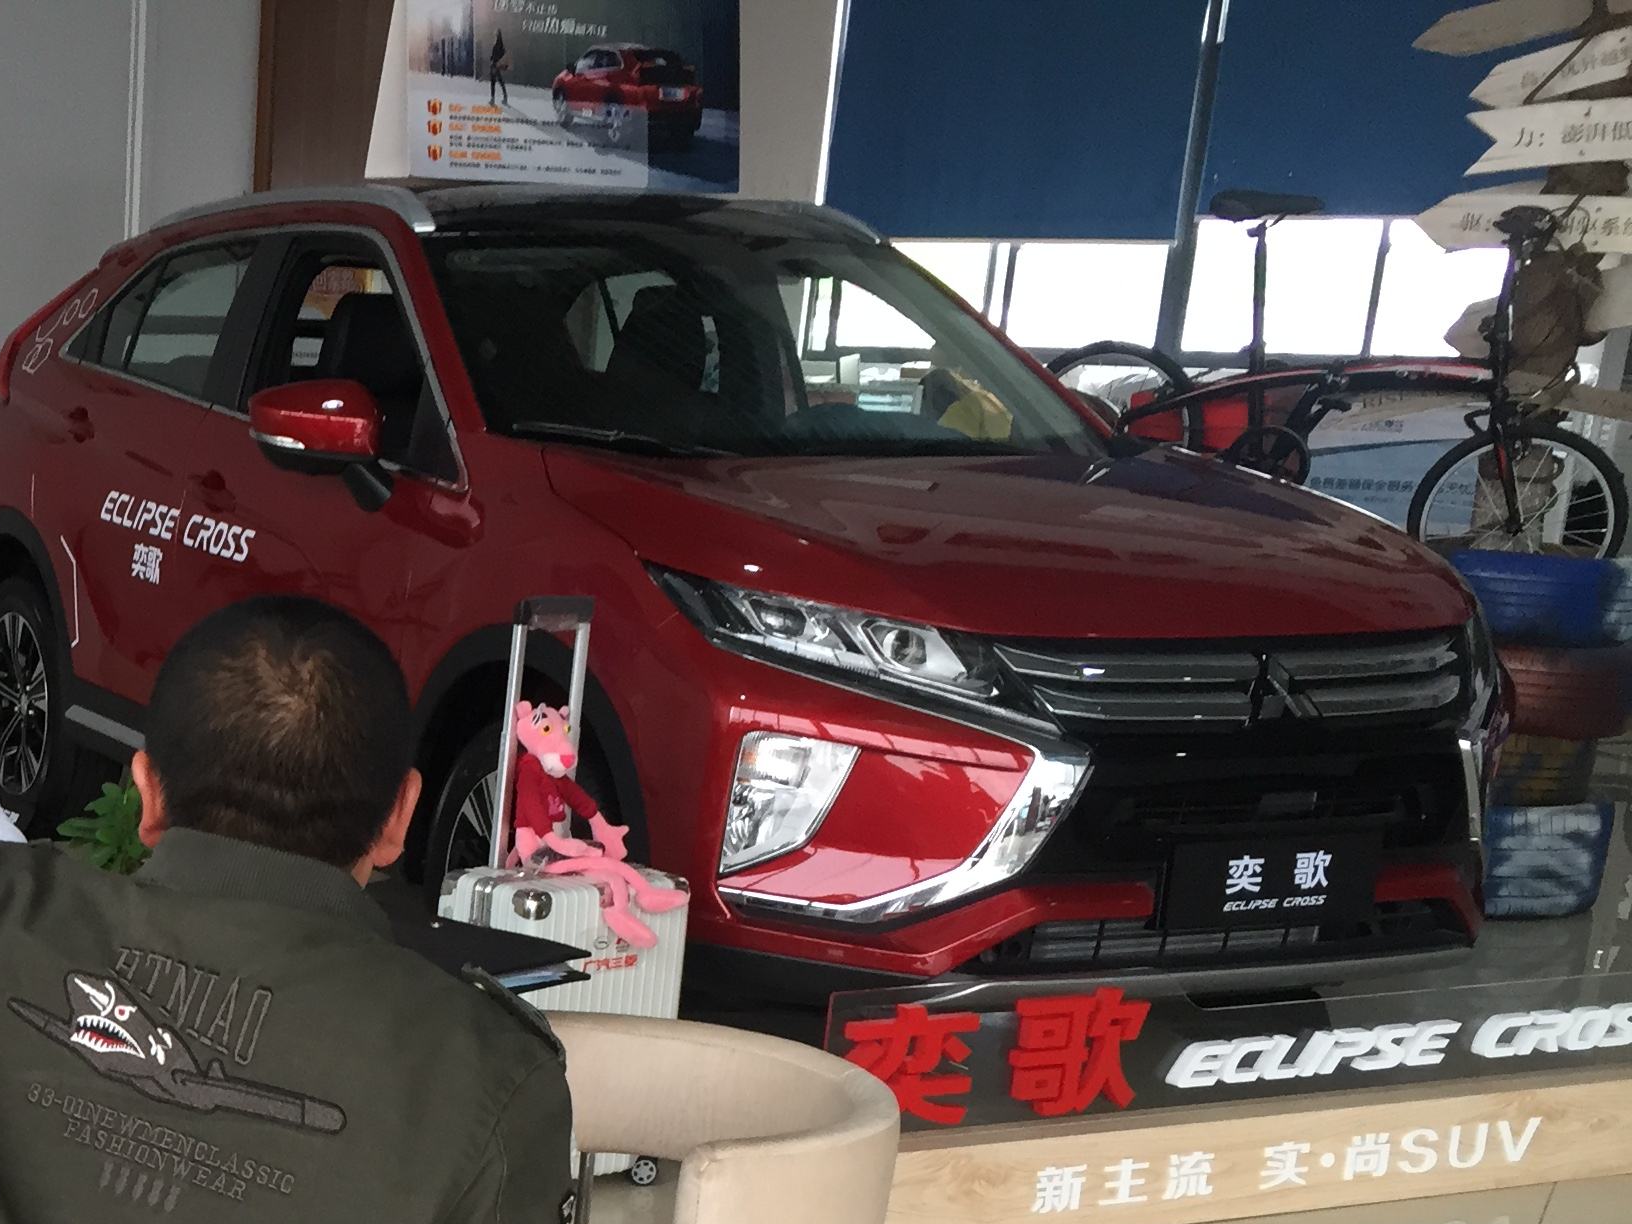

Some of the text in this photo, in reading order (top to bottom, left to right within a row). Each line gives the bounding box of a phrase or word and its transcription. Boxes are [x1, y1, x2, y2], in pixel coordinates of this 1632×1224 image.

[100, 490, 256, 562] ECLIPSE CROSS
[131, 542, 163, 584] 奕歌
[1223, 895, 1327, 912] ECLIPSE CROSS
[1225, 850, 1332, 894] 奕歌
[843, 987, 1152, 1126] 奕歌
[1165, 1019, 1462, 1088] ECLIPSE
[1031, 1151, 1215, 1214] 新主流
